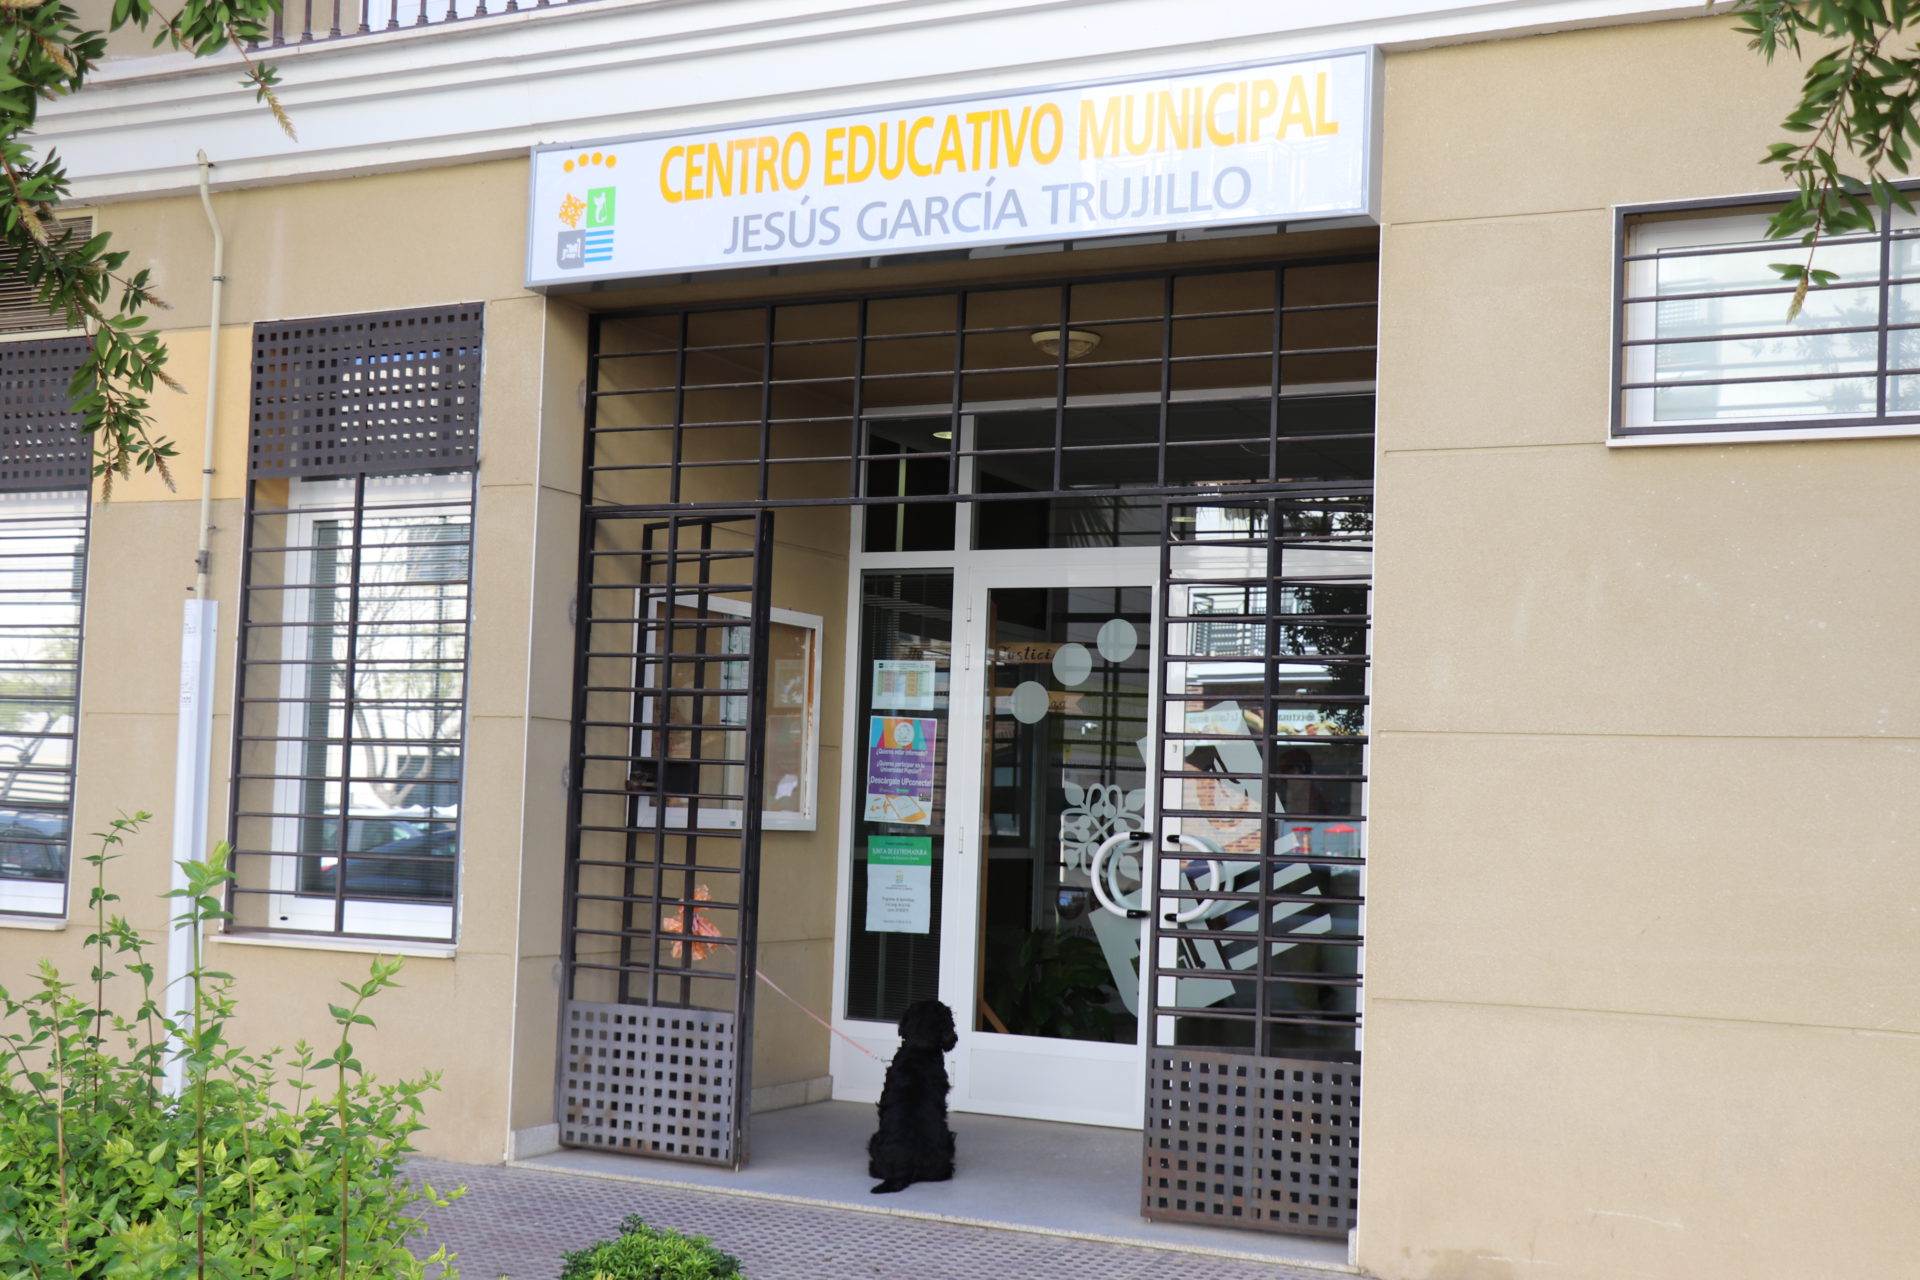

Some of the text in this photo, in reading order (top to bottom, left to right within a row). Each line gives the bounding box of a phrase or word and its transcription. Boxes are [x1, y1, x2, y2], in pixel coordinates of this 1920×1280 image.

[659, 72, 1339, 203] CENTRO EDUCATIVO MUNICIPAL
[723, 166, 1252, 255] JESÚS GARCÍA TRUJILLO
[887, 847, 893, 855] DE
